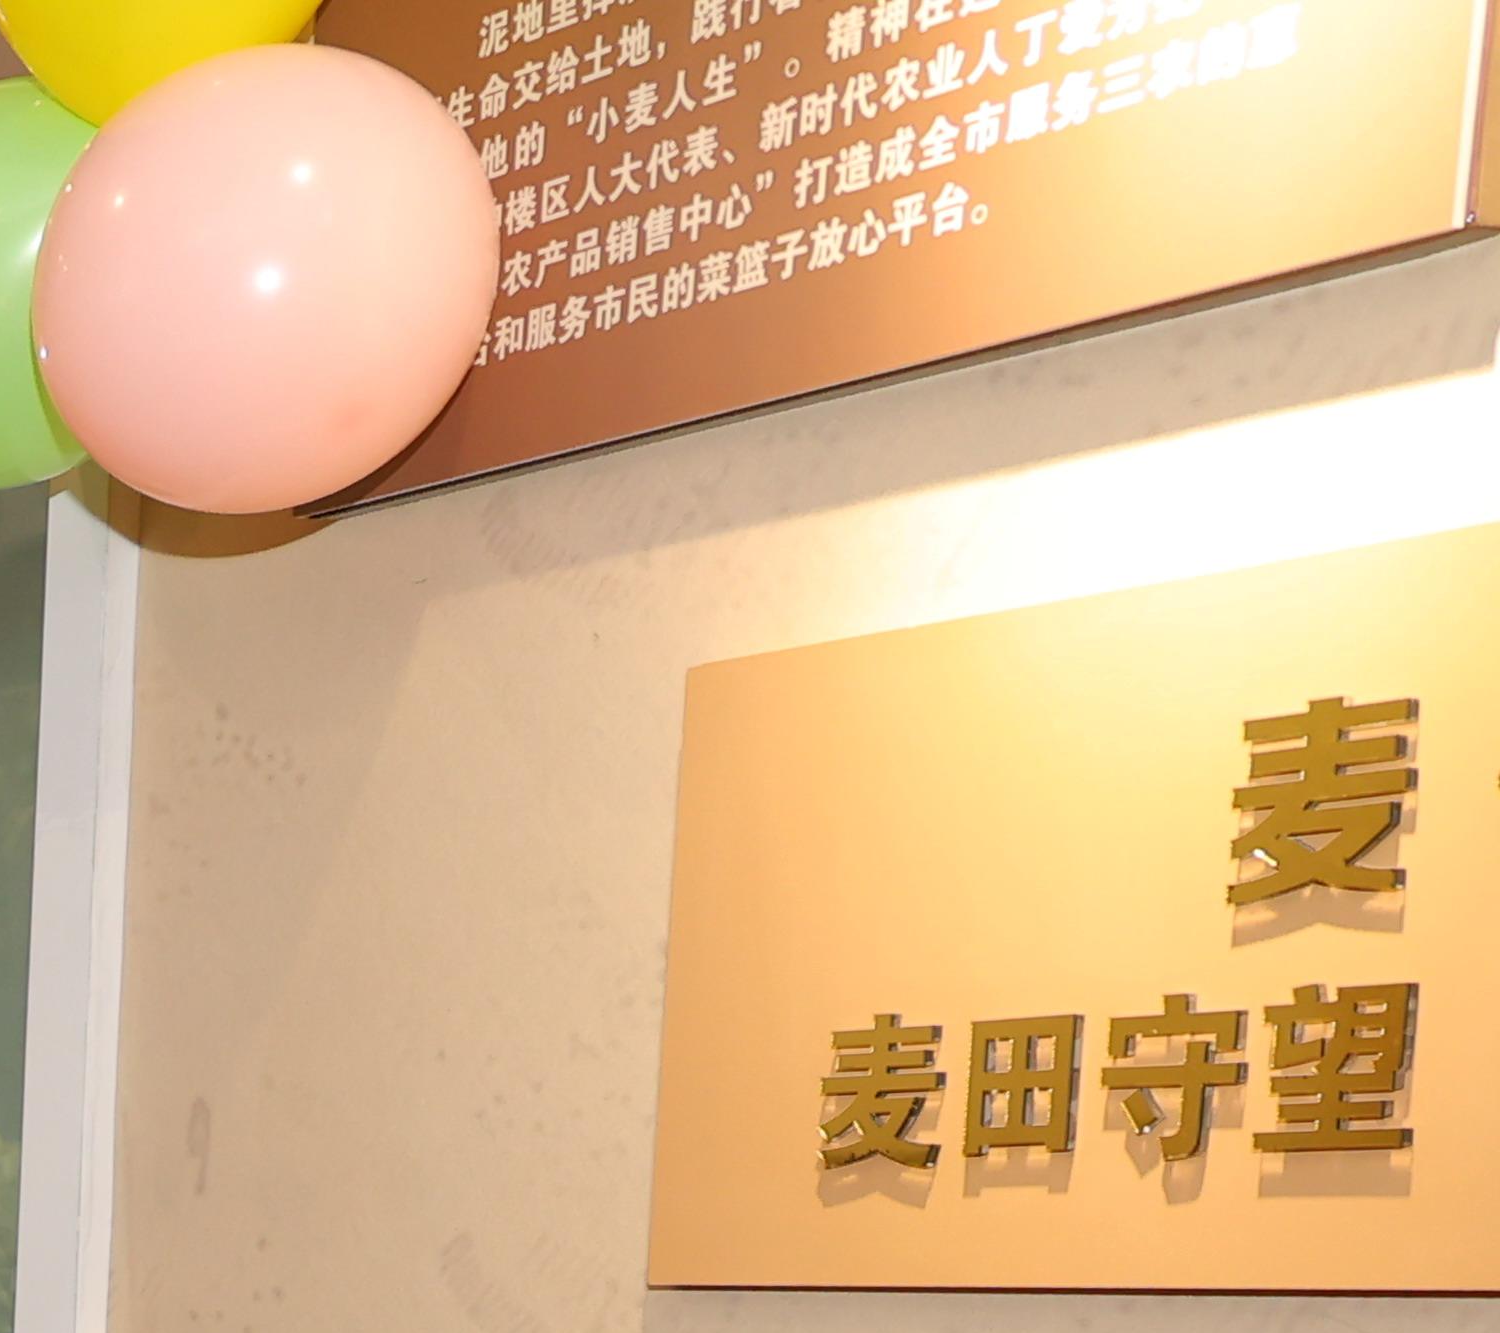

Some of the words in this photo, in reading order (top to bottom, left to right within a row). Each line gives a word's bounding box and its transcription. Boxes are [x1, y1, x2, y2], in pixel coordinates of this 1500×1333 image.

[437, 0, 800, 131] 生命交给土地，践行
[478, 0, 635, 58] 泥地里
[479, 0, 998, 180] 他的“小麦人生”。精神在
[494, 0, 1202, 236] 楼区人大代表、新时代农业人丁爱
[1227, 696, 1420, 906] 麦
[816, 982, 1420, 1170] 麦田守望
